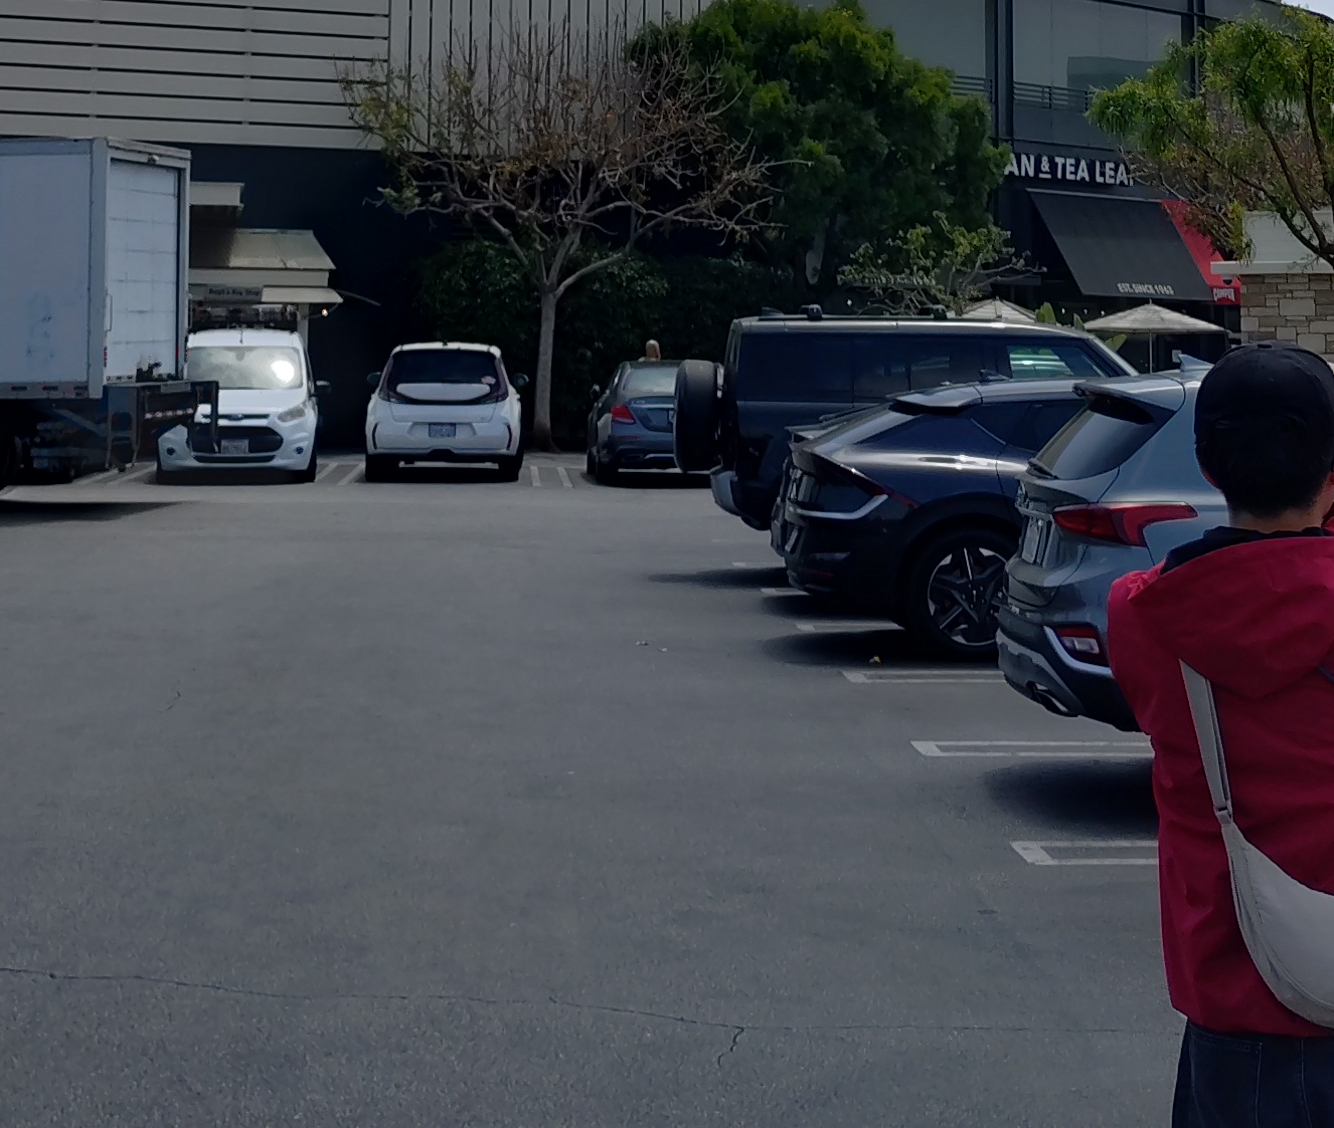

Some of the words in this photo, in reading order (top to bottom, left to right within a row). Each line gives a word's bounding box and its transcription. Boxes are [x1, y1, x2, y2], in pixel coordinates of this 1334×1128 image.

[1004, 152, 1035, 178] AN
[1039, 156, 1052, 179] &
[1054, 157, 1090, 182] TEA
[1095, 160, 1134, 186] LEA
